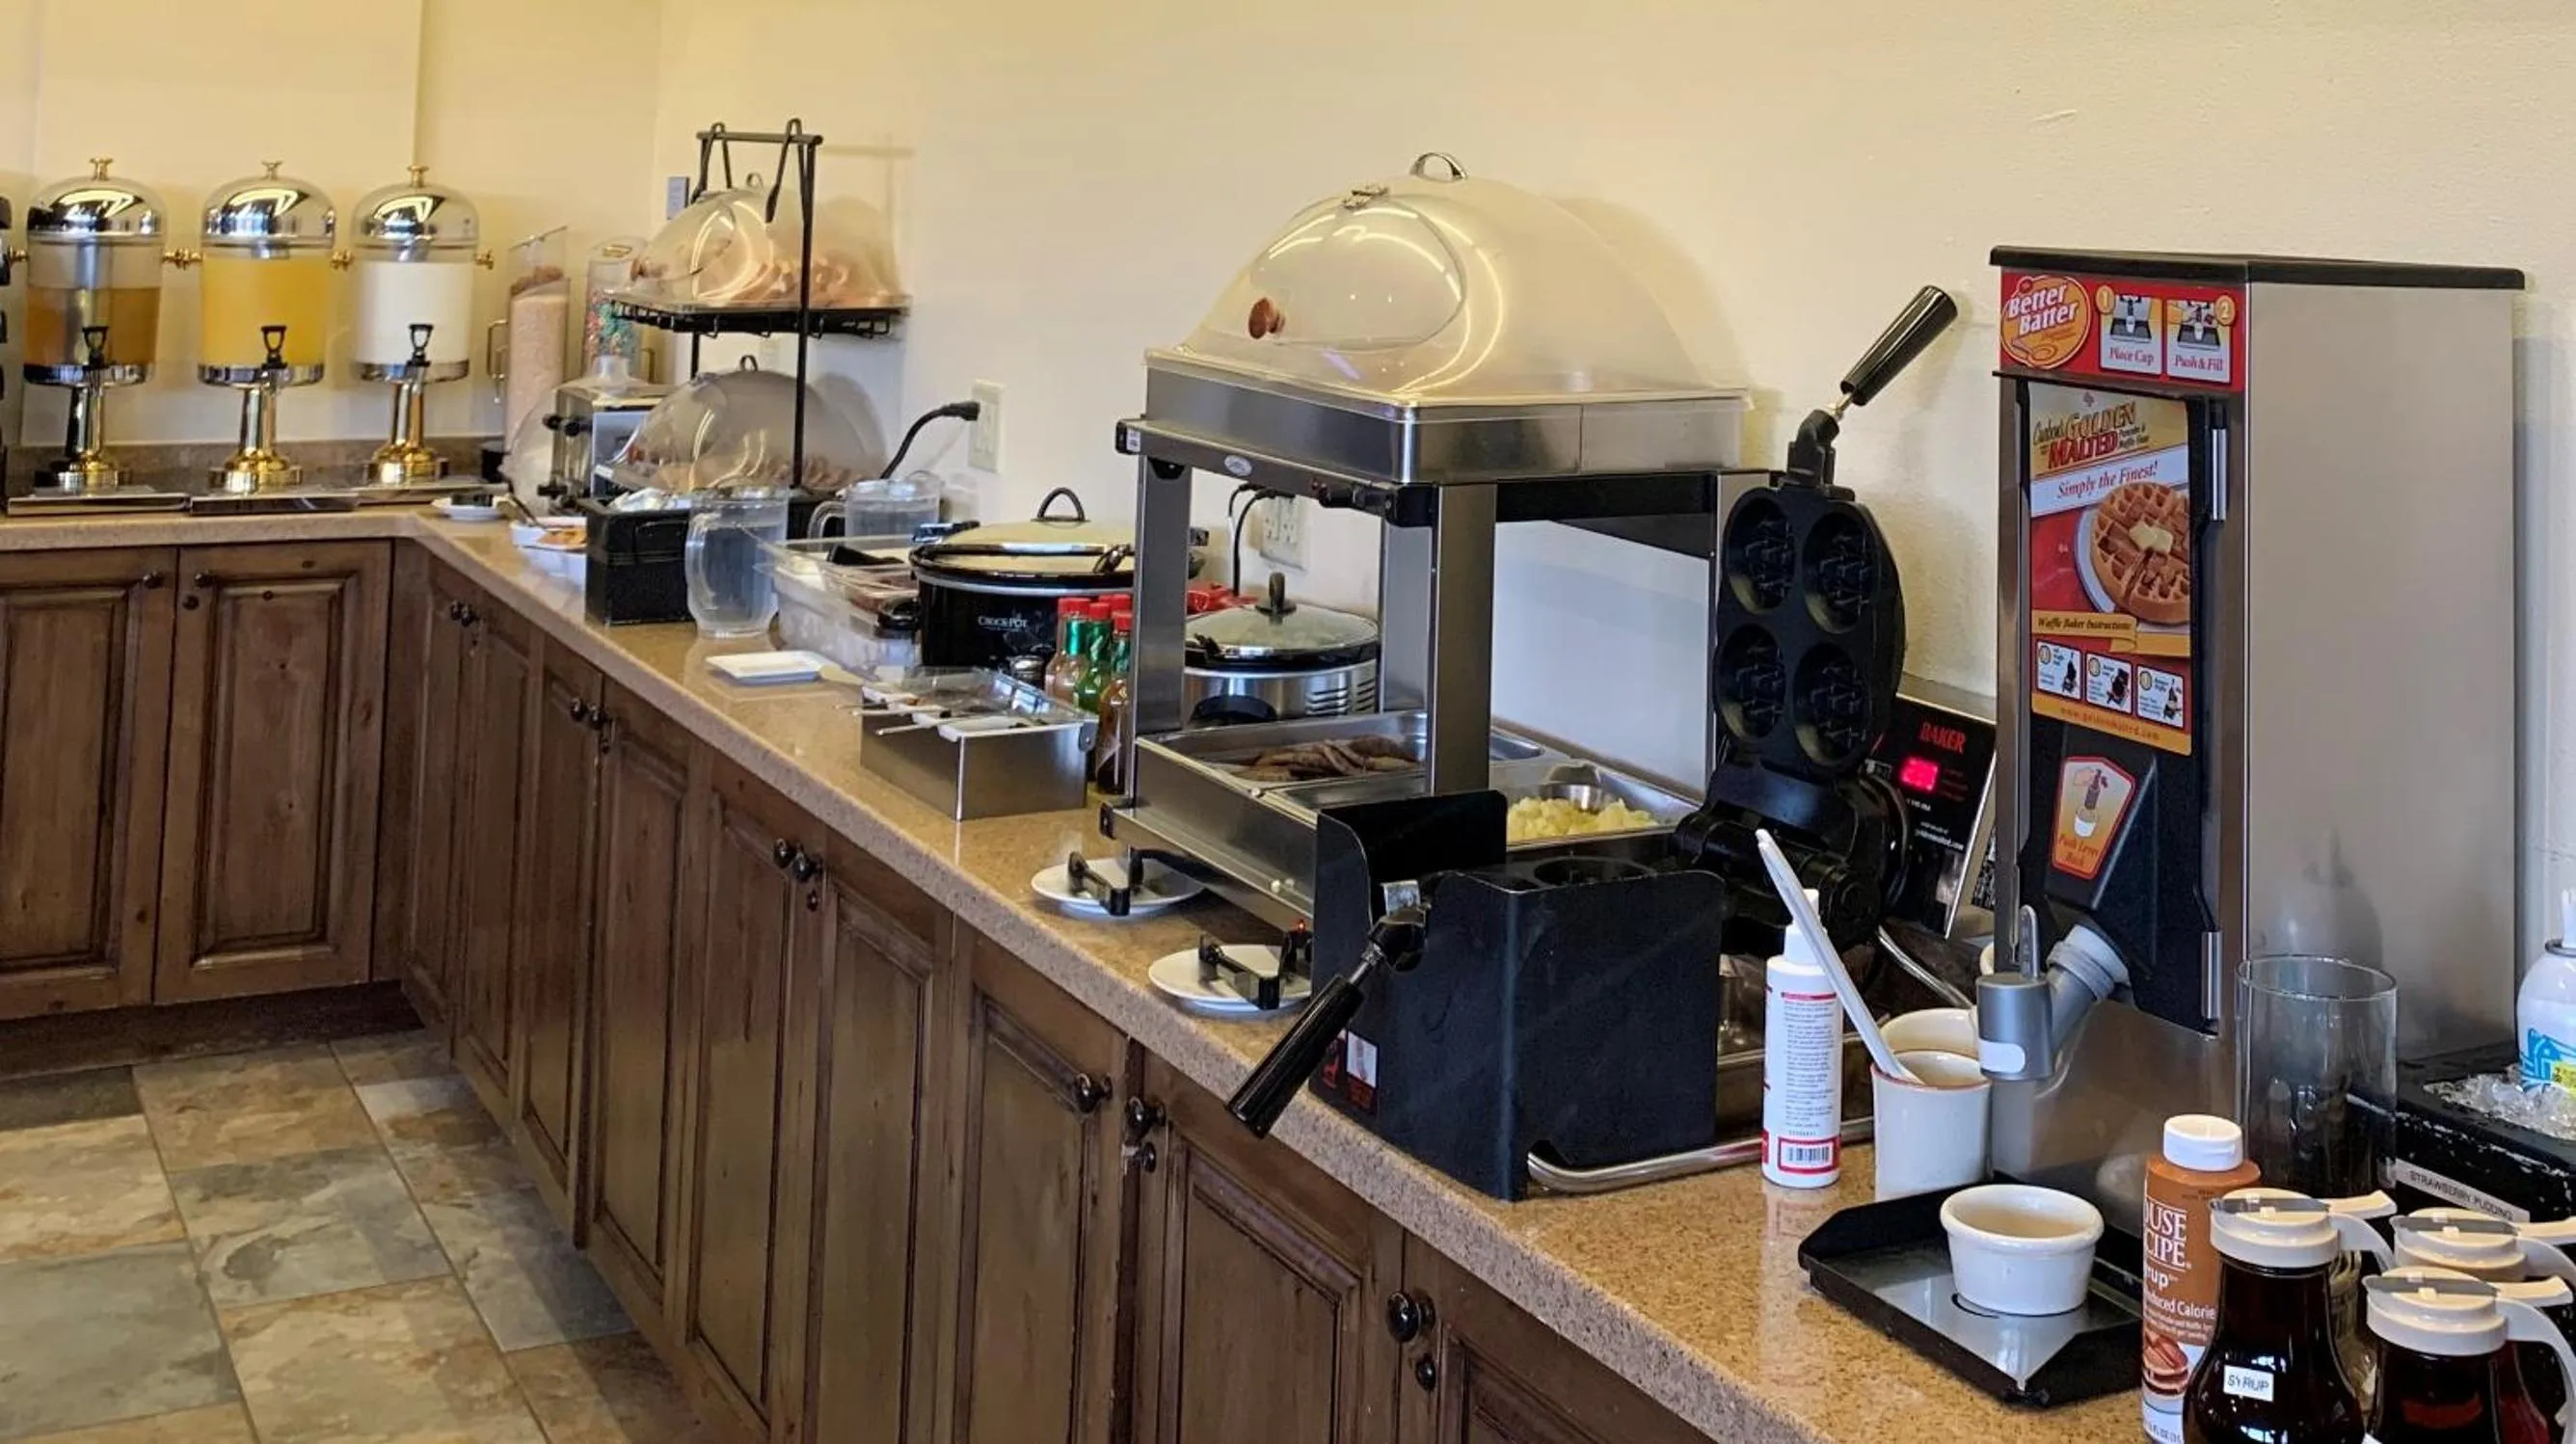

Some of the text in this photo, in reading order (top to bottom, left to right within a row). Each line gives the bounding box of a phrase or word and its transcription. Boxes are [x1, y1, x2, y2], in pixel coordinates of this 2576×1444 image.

[2008, 283, 2067, 319] Better
[2019, 300, 2079, 336] Batter
[2048, 431, 2118, 469] MALTED
[2056, 460, 2158, 498] Simply the Finest!
[1919, 722, 1966, 754] BAKER
[2144, 1201, 2187, 1241] OUSE
[2144, 1228, 2186, 1267] CIPE
[2178, 1300, 2216, 1320] Calorie
